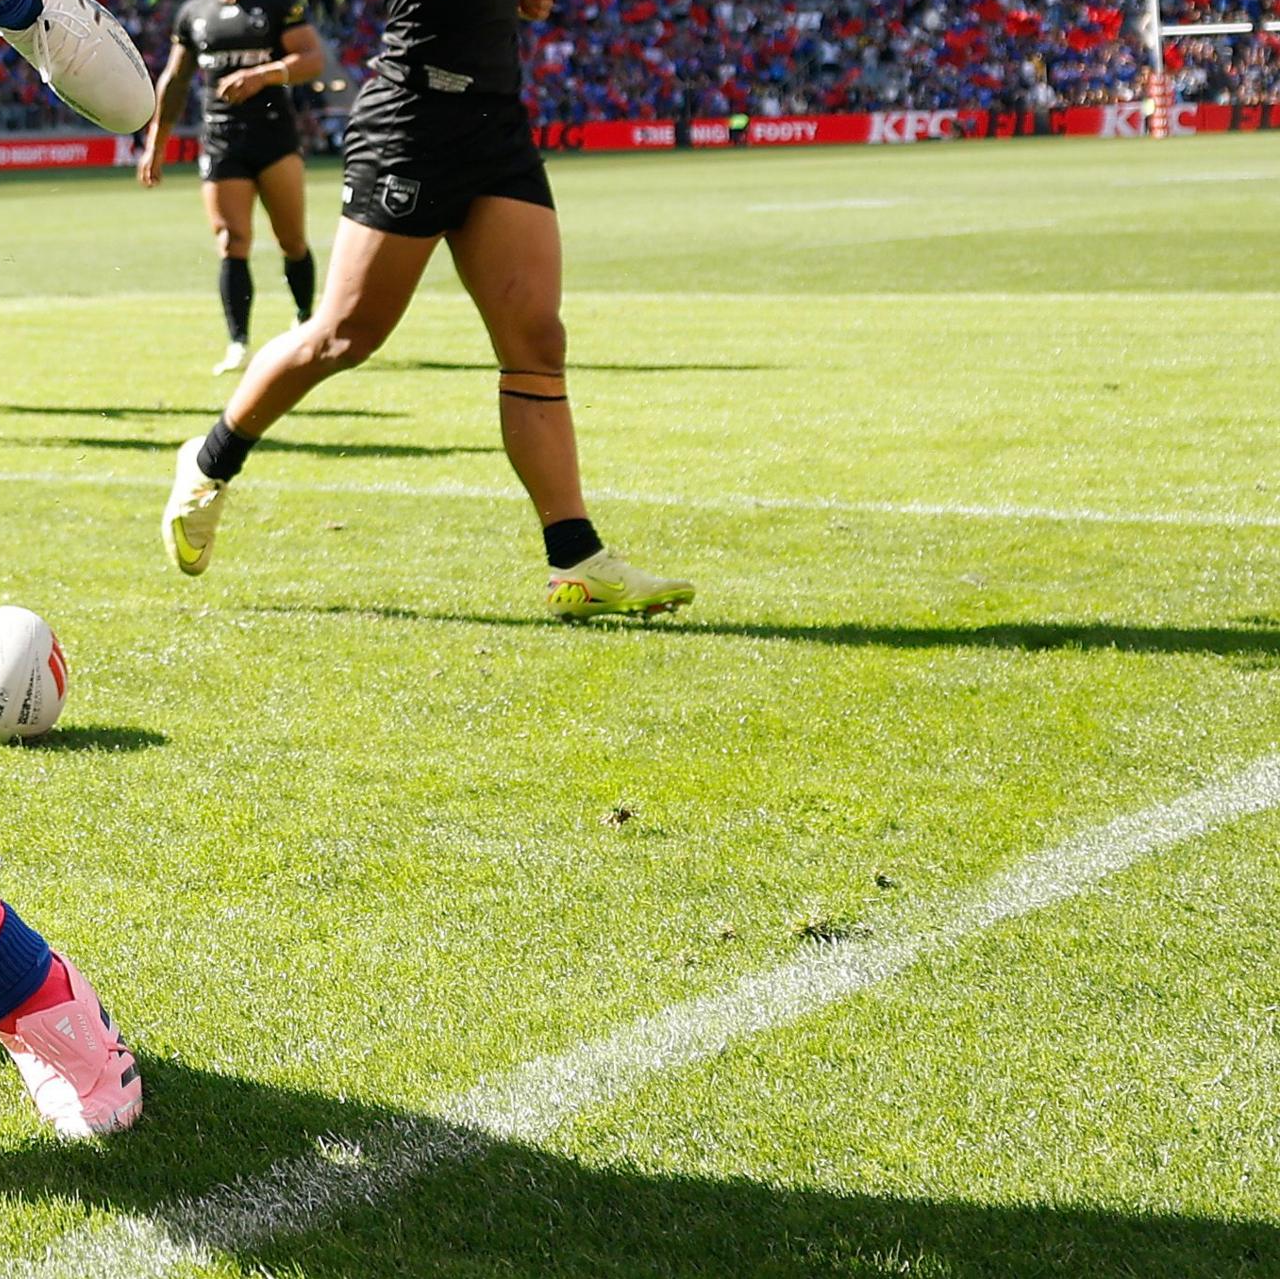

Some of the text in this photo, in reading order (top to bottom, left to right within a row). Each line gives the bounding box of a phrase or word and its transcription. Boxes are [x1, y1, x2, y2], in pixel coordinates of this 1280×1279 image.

[632, 121, 818, 146] FRIE NIG FOOTY
[869, 109, 958, 144] KFC
[1101, 102, 1198, 137] KC
